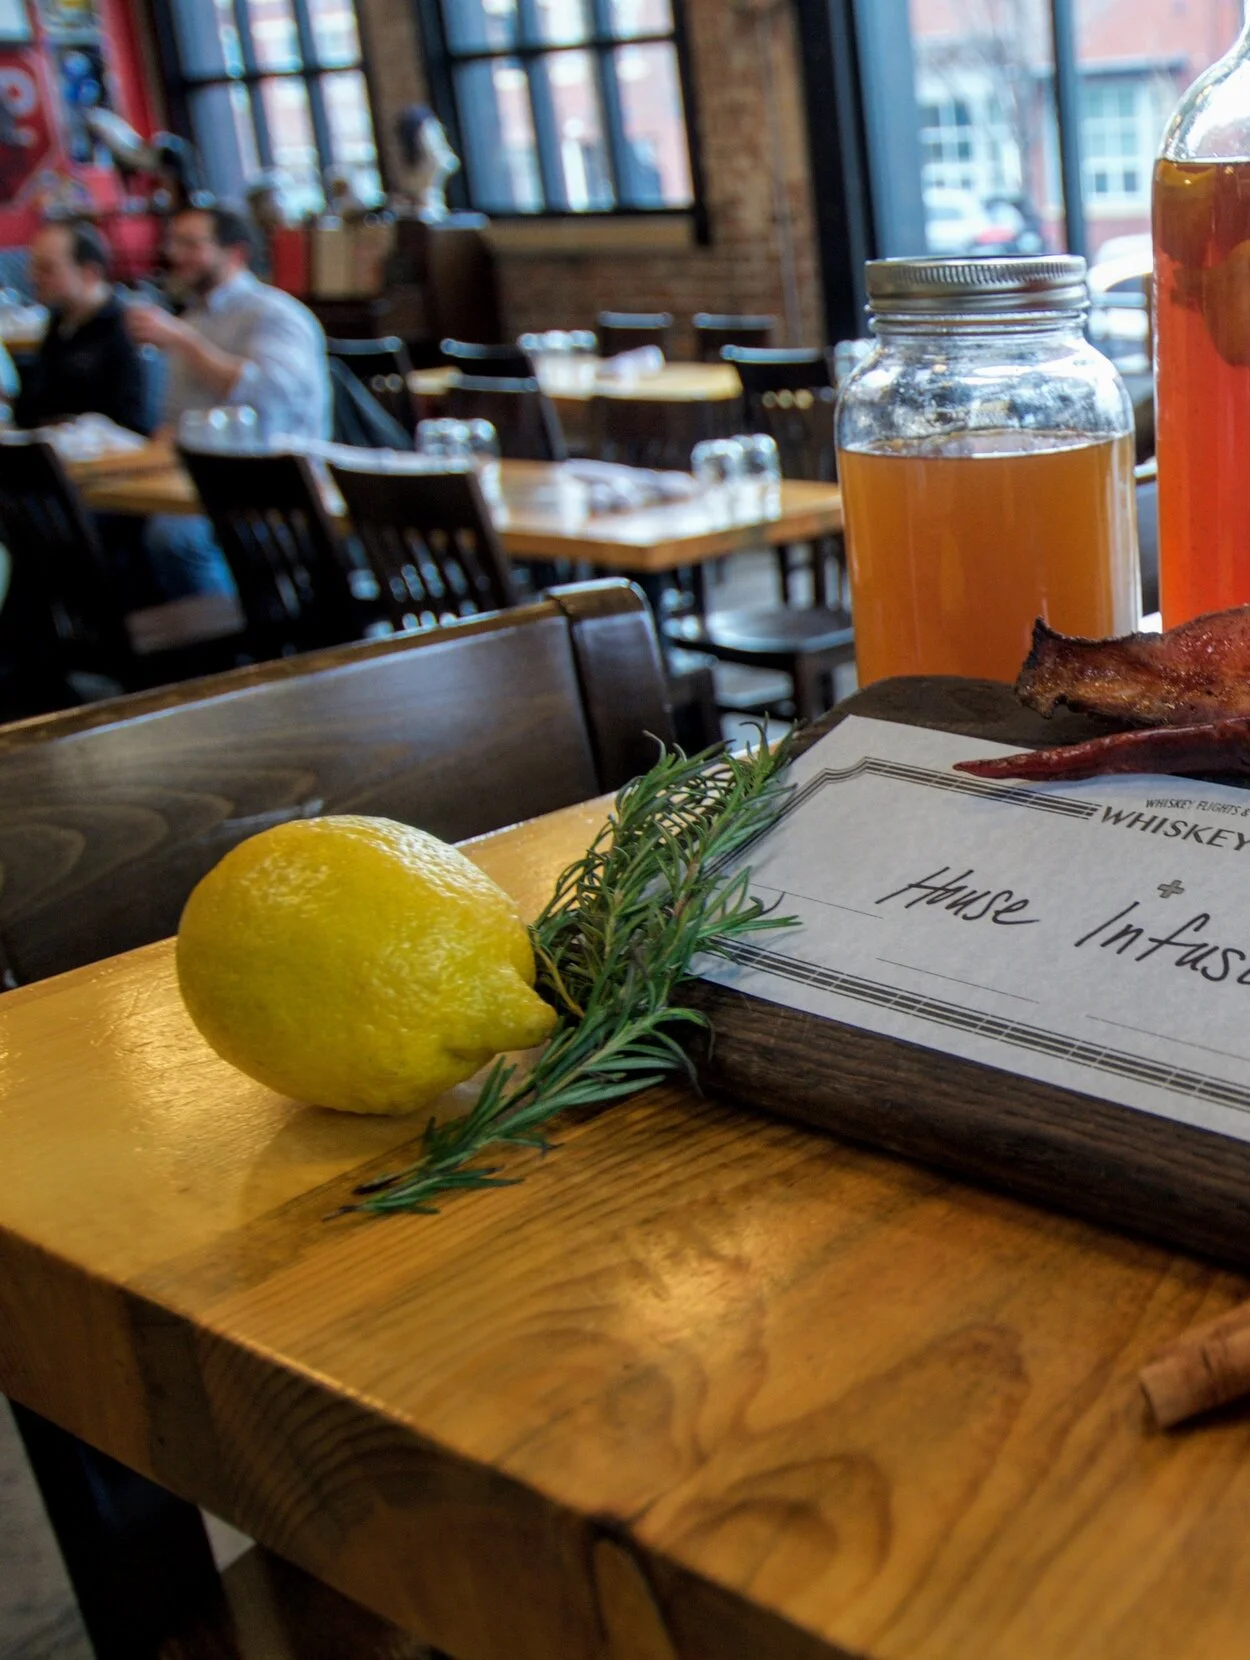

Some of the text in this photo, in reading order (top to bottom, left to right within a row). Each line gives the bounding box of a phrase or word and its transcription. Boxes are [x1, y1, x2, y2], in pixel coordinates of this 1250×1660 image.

[1145, 799, 1194, 809] WHISKEY
[1197, 800, 1242, 816] FLIGHTS
[1241, 808, 1250, 817] &
[875, 866, 1041, 925] House
